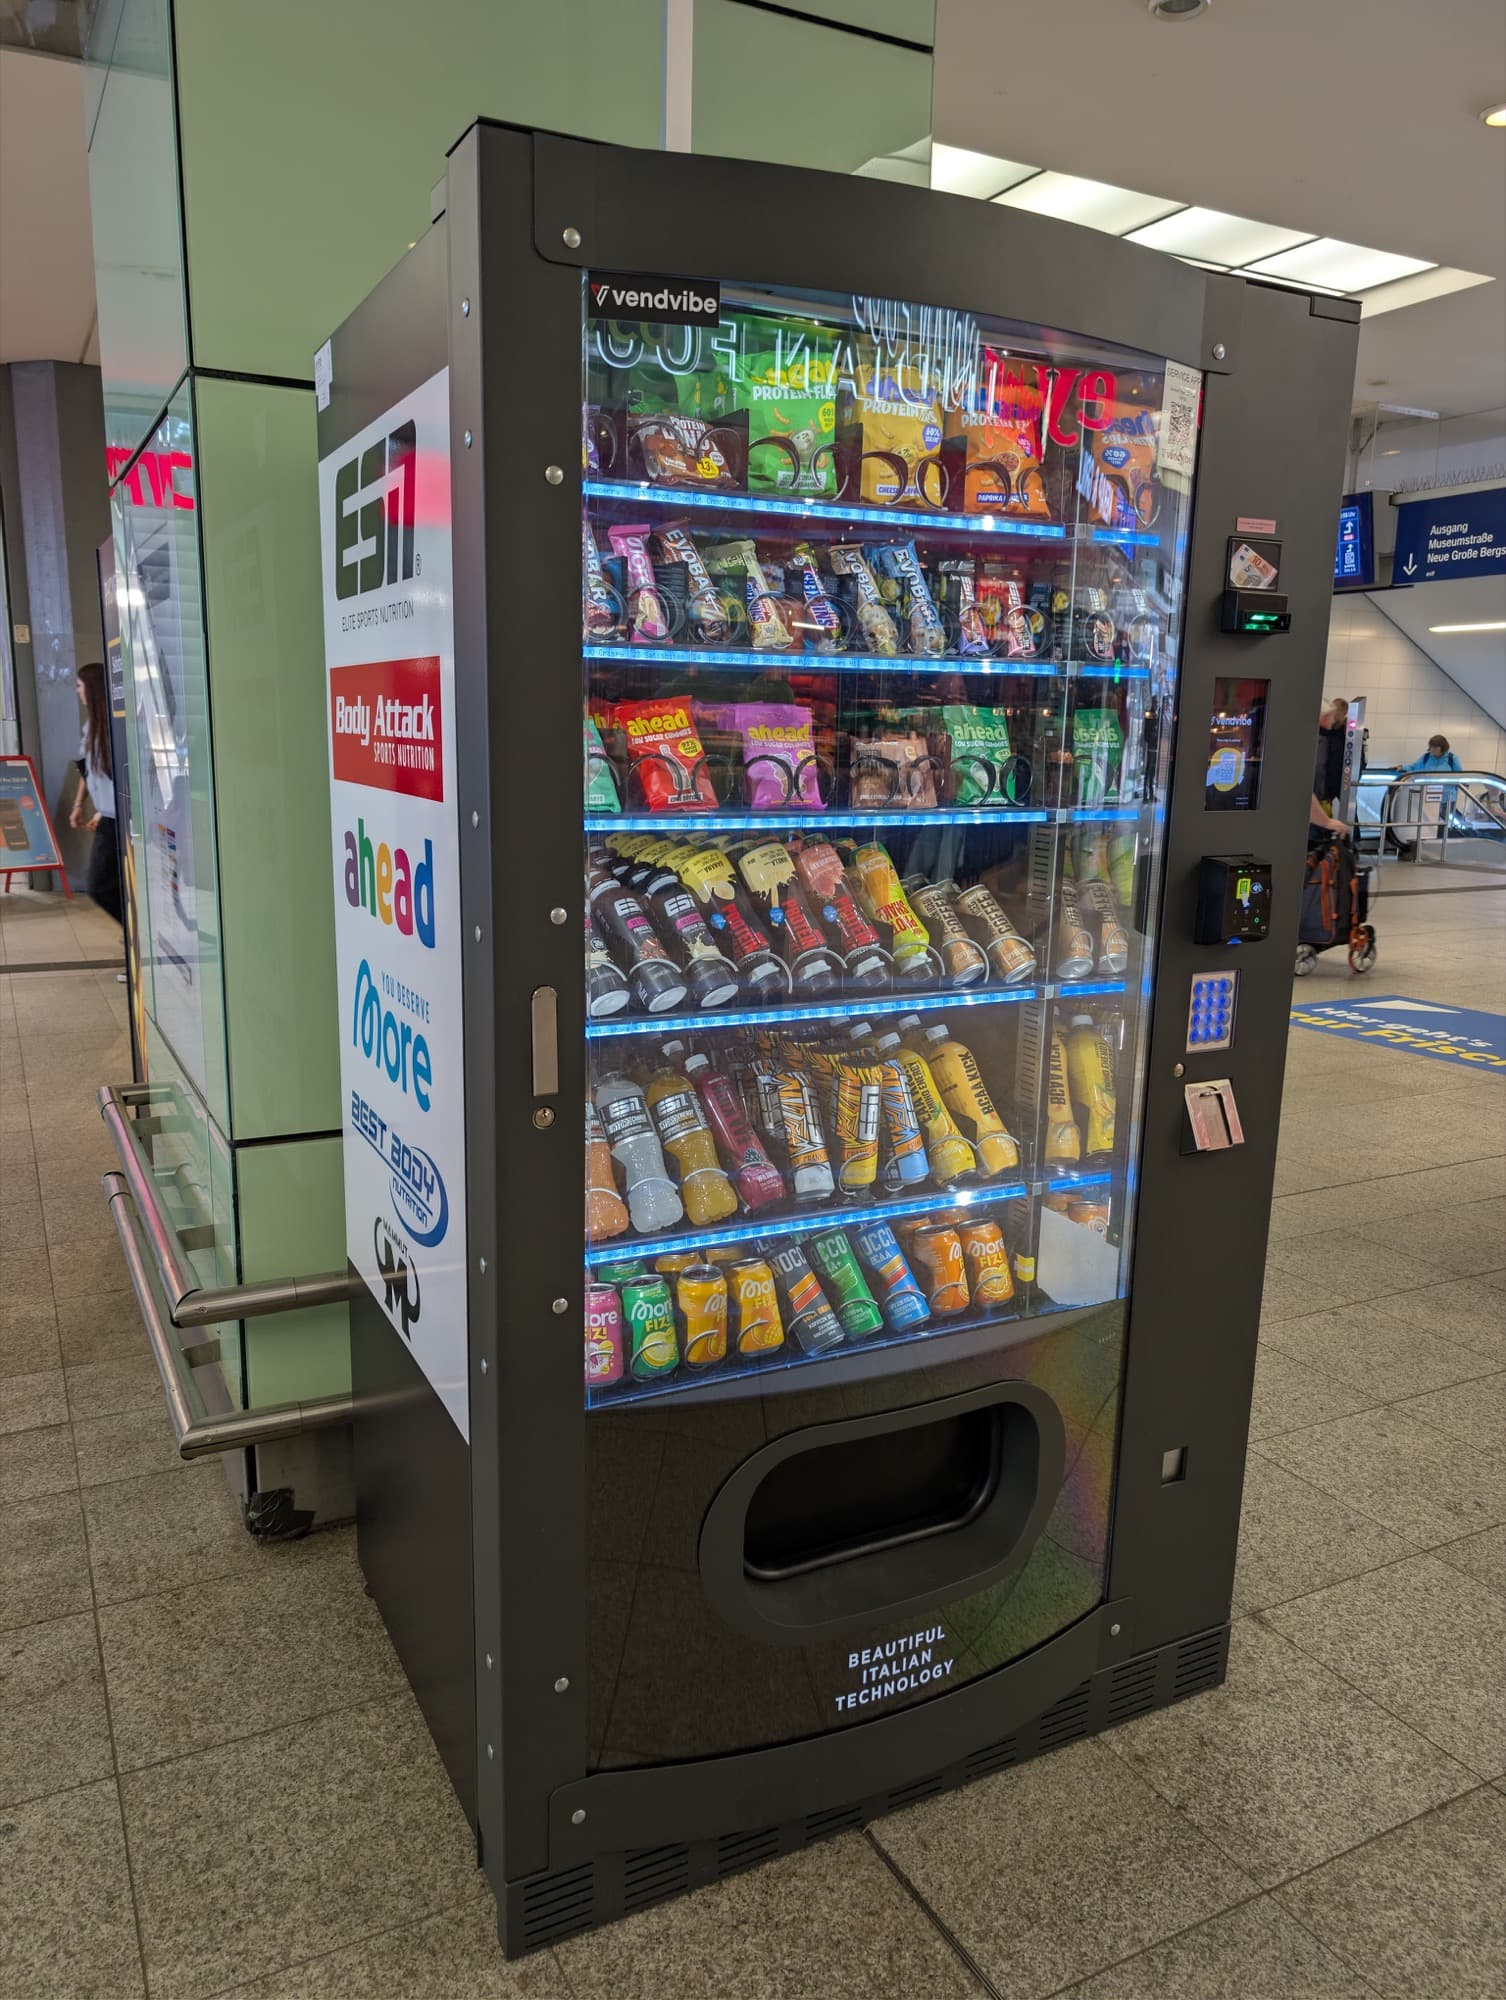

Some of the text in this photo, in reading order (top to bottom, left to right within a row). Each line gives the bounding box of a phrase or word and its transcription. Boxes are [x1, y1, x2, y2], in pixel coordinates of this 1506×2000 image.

[612, 288, 718, 314] vendvibe
[878, 486, 900, 494] CHEES
[1428, 532, 1493, 549] Museumstraße
[1430, 523, 1468, 536] Ausgang
[1427, 552, 1449, 563] Neue
[1451, 548, 1477, 561] Große
[342, 601, 414, 632] ELITE SPORTS NUTRITION
[335, 693, 435, 746] Body Attack
[627, 708, 690, 736] ahead
[747, 724, 811, 742] ahead
[953, 722, 1007, 742] ahead
[373, 741, 435, 772] SPORTS NUTRITION
[344, 817, 435, 949] ahead
[931, 893, 961, 934] COFFEE
[977, 894, 1013, 934] COFFEE
[382, 971, 430, 1024] YOU DESERVE
[1312, 1007, 1385, 1024] Hier
[908, 1060, 928, 1091] ENERGY
[958, 1051, 993, 1116] BCAA KICK
[352, 1089, 435, 1202] BEST BODY
[382, 1217, 409, 1259] MAMMUT
[848, 1625, 945, 1669] BEAUTIFUL
[862, 1648, 932, 1685] ITALIAN
[835, 1658, 954, 1712] TECHNOLOGY
